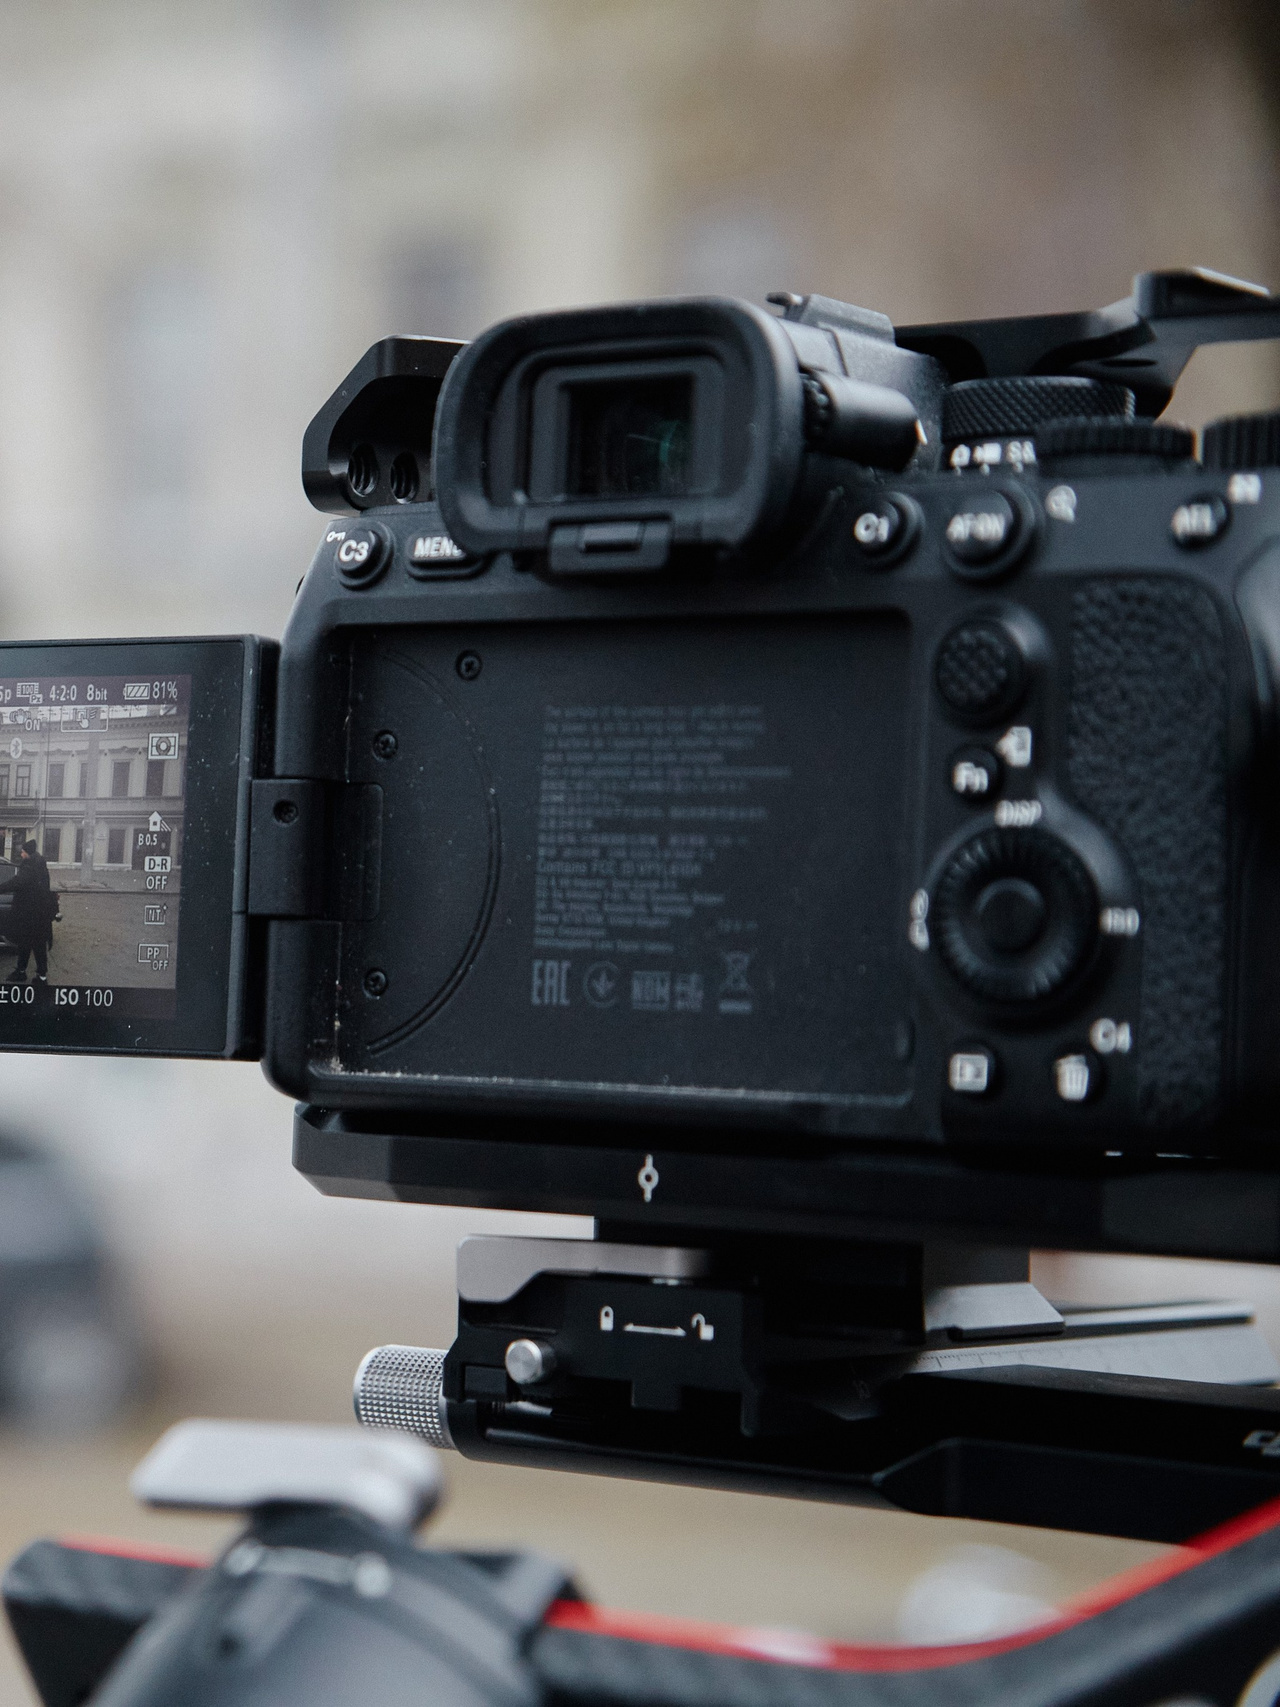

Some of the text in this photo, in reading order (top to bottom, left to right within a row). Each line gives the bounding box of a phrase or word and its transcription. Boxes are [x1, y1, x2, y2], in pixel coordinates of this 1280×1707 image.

[339, 540, 369, 562] C3
[49, 685, 77, 701] 4:2:0
[152, 681, 178, 700] 81%
[25, 719, 41, 731] ON
[148, 858, 168, 871] D-R
[146, 876, 168, 890] OFF
[147, 947, 160, 960] PP
[152, 960, 168, 971] OFF
[55, 988, 113, 1007] ISO 100
